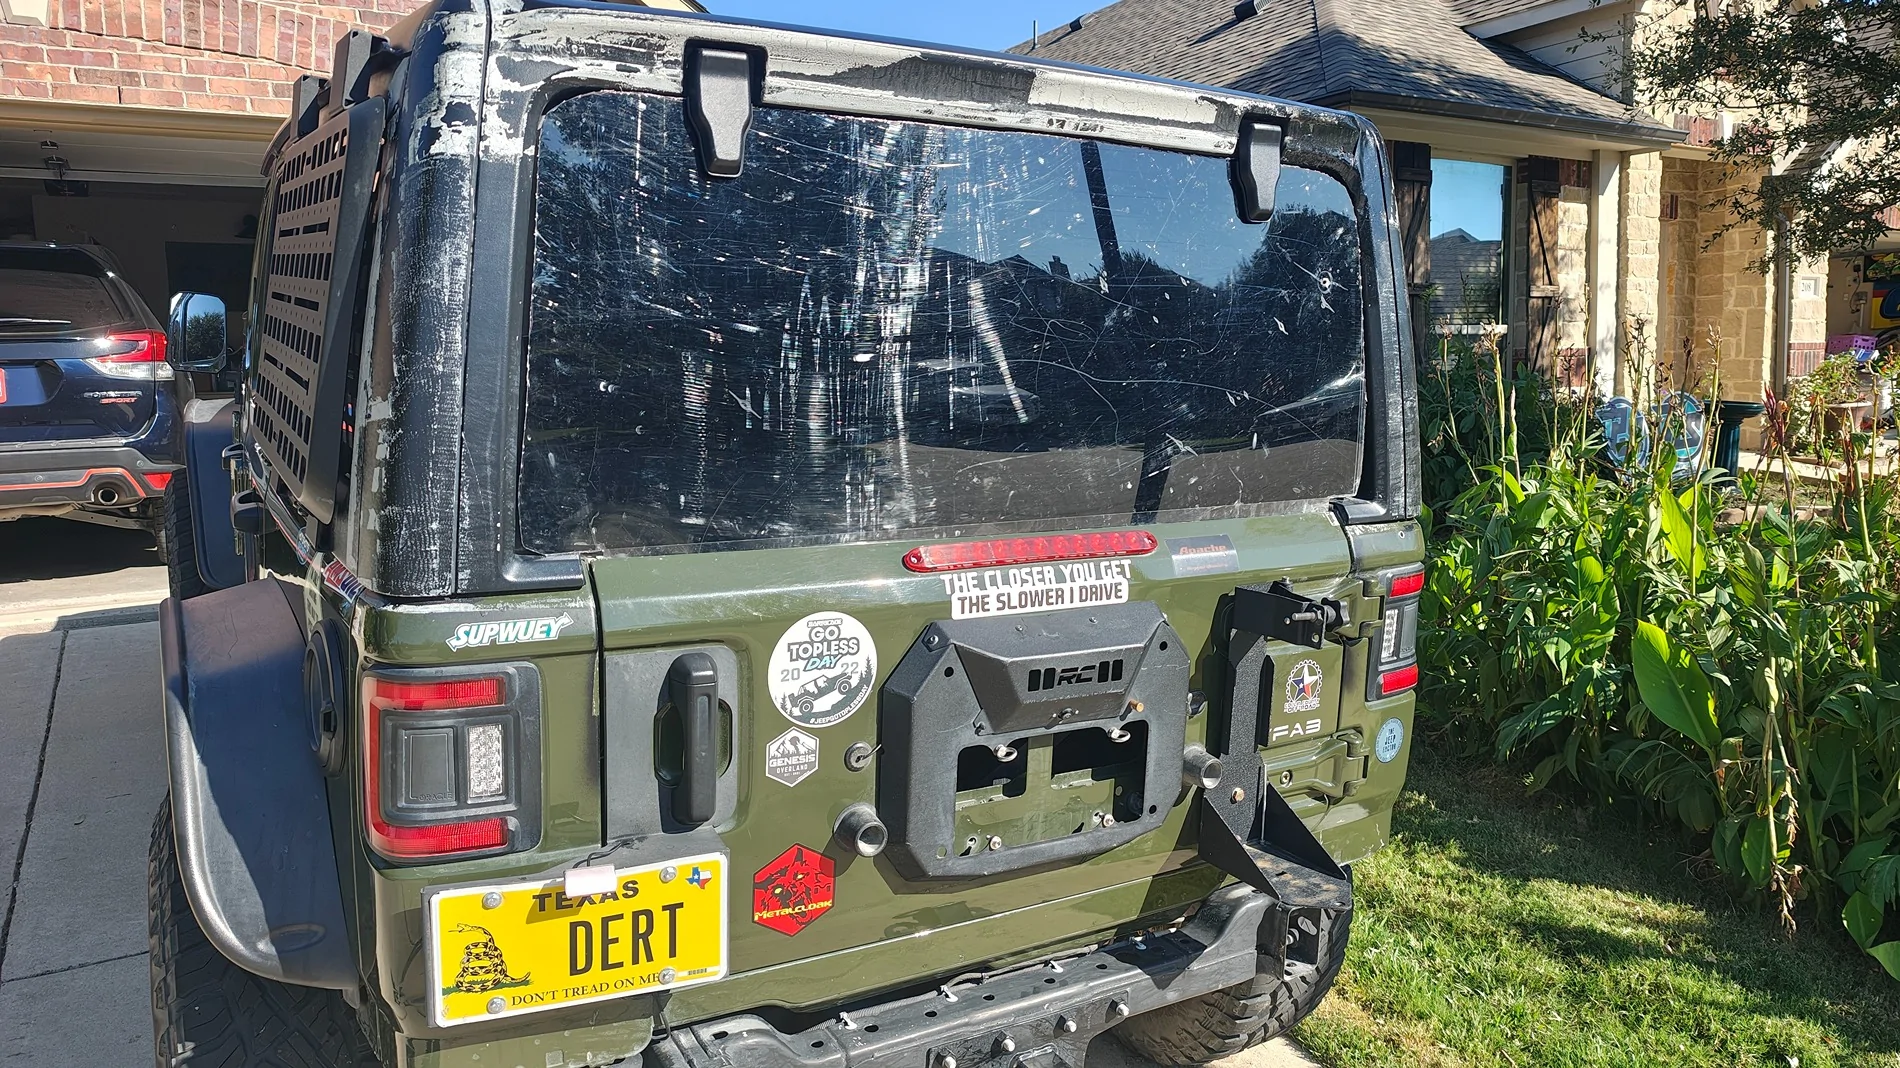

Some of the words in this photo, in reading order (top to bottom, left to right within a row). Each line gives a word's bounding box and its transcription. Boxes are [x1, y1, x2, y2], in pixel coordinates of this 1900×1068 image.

[1801, 282, 1812, 292] 208
[1179, 544, 1227, 555] Apache
[940, 573, 981, 595] THE
[984, 566, 1057, 590] CLOSER
[1059, 562, 1098, 584] YOU
[1100, 559, 1132, 581] GET
[957, 594, 991, 614] THE
[996, 586, 1065, 611] SLOWER
[1069, 586, 1074, 604] I
[1078, 582, 1123, 603] DRIVE
[448, 614, 571, 649] SUPWUEY
[810, 626, 840, 641] GO
[788, 638, 859, 661] TOPLESS
[804, 655, 841, 670] DAY
[780, 668, 800, 682] 20
[1270, 719, 1321, 741] FAB
[769, 753, 816, 767] GENESIS
[776, 763, 808, 774] OVERLAND
[418, 792, 453, 801] ORACLE
[569, 902, 684, 976] DERT
[511, 990, 558, 1006] DON'T
[562, 982, 609, 998] TREAD
[614, 977, 635, 990] ON
